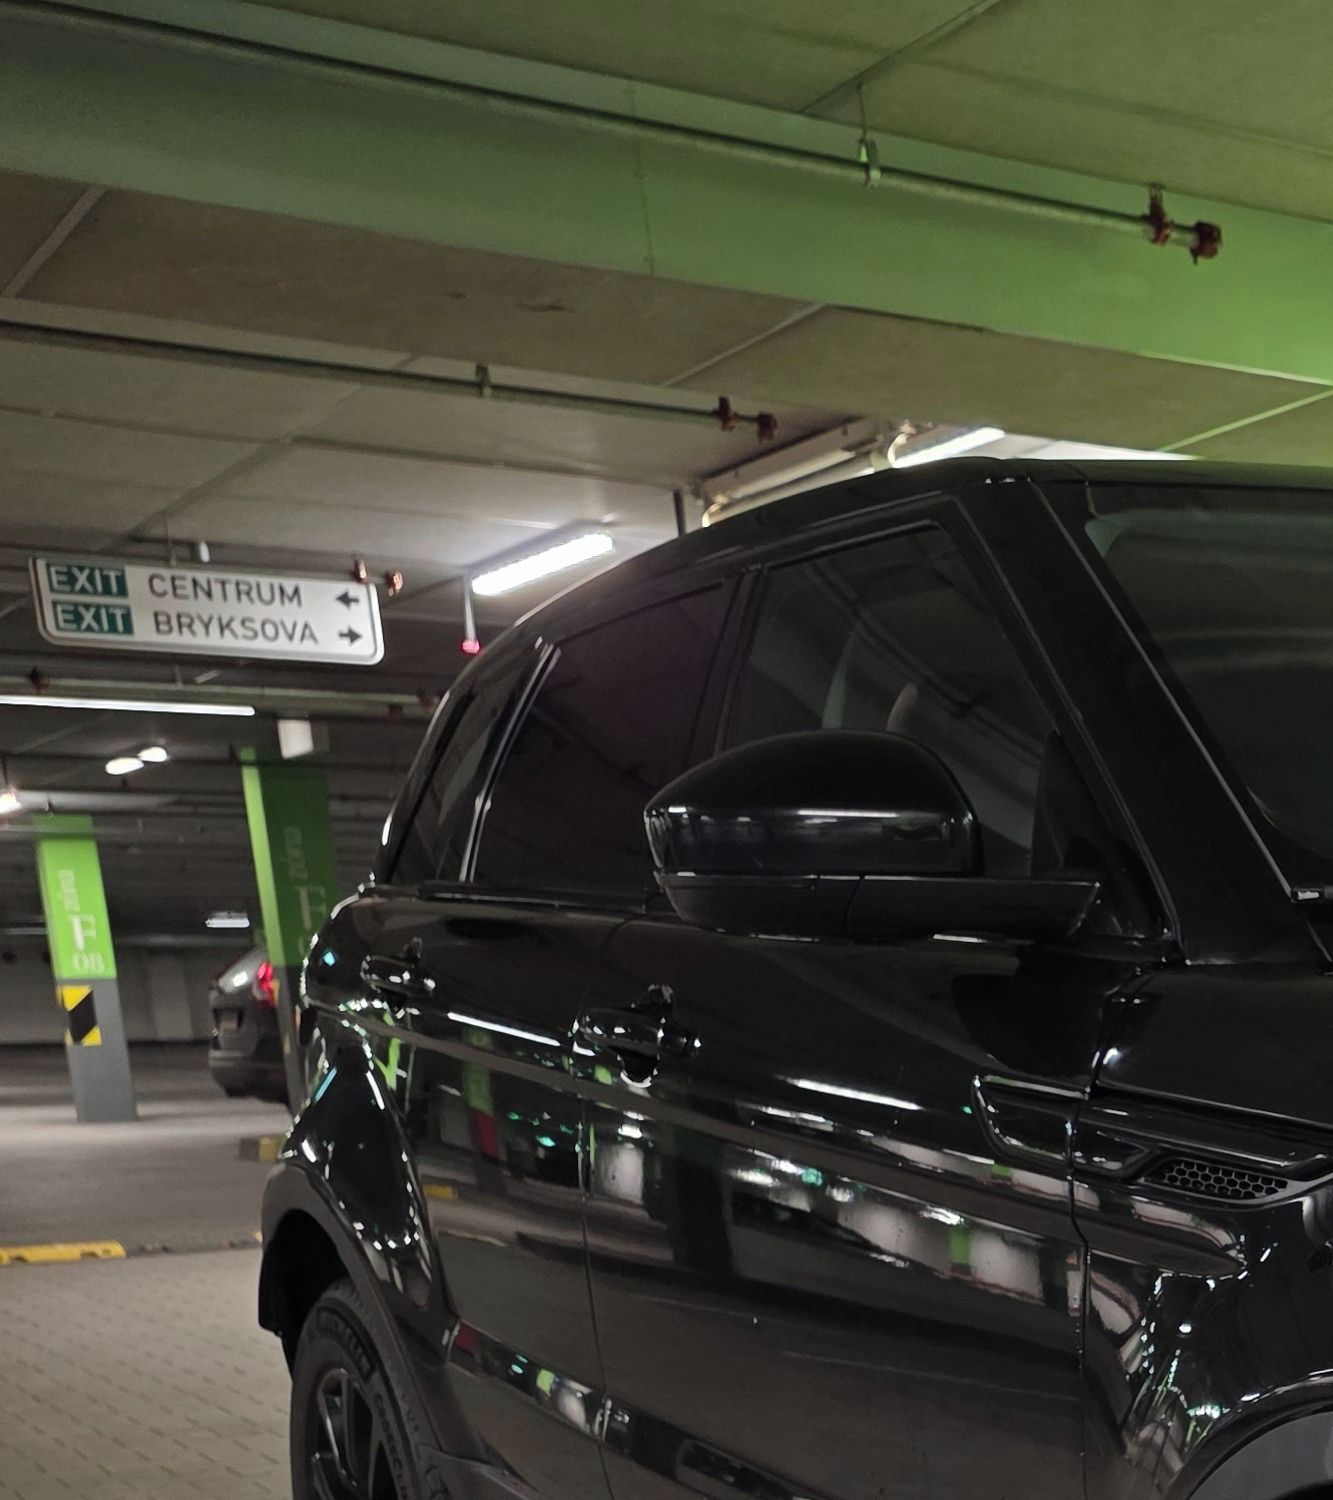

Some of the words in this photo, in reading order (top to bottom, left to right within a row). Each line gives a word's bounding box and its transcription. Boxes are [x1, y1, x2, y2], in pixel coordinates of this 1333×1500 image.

[49, 567, 123, 595] EXIT
[148, 573, 302, 607] CENTRUM
[55, 605, 129, 633] EXIT
[153, 611, 319, 644] BRYKSOVA
